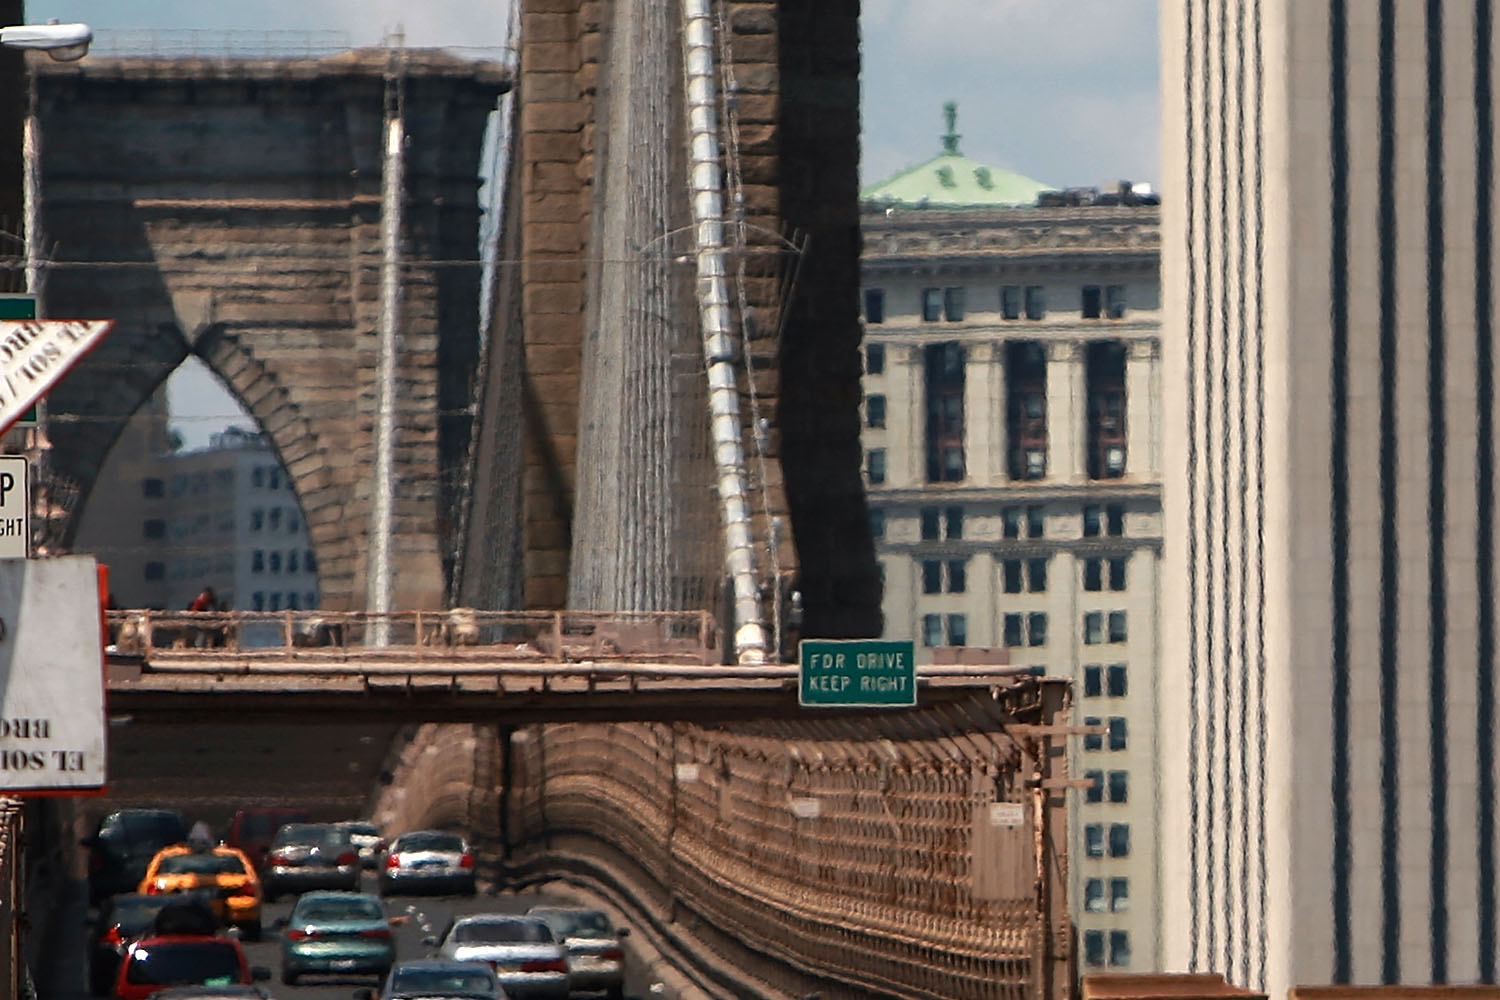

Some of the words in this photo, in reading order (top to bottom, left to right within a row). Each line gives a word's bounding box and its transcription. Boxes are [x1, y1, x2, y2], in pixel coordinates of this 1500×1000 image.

[810, 653, 846, 669] FDR
[856, 652, 904, 669] DRIVE
[809, 676, 851, 691] KEEP
[860, 676, 907, 691] RIGHT
[52, 751, 84, 771] EL
